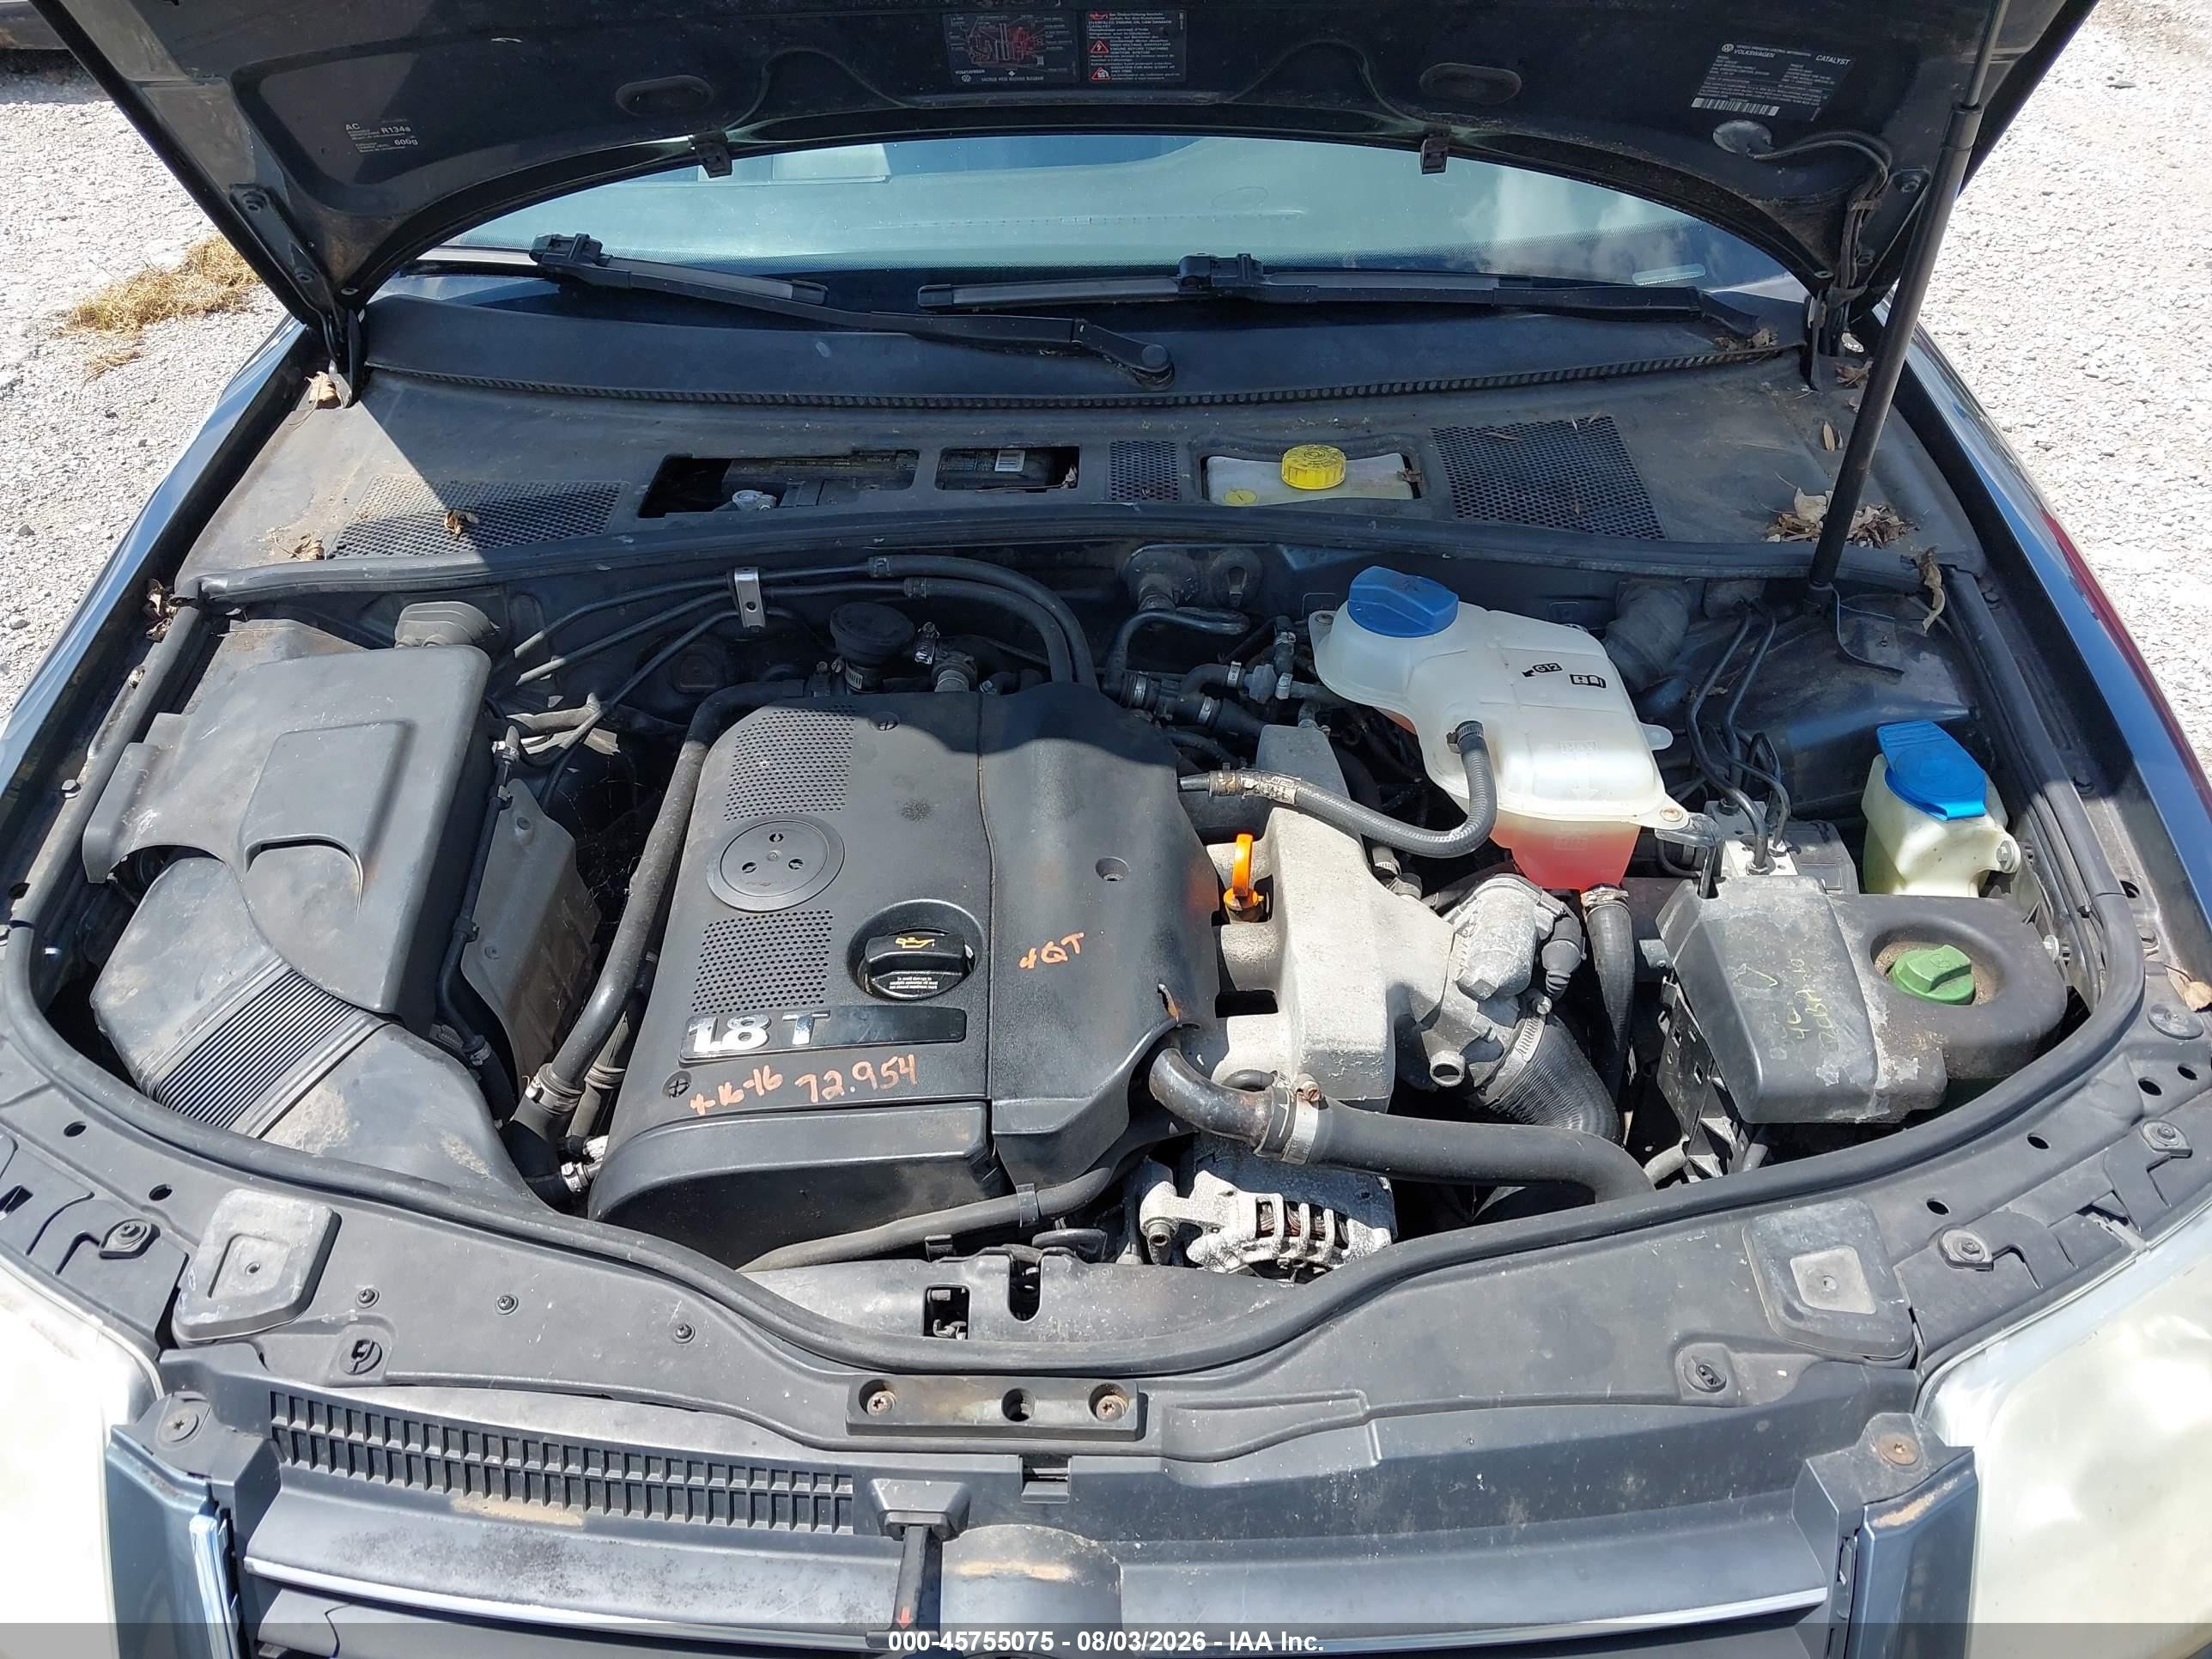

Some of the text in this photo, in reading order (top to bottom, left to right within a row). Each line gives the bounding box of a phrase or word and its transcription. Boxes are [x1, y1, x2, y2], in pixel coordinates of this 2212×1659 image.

[1733, 48, 1776, 58] VOLKSWAGEN
[1815, 54, 1850, 65] CATALYST
[1535, 664, 1560, 672] G12
[782, 1010, 830, 1045] T
